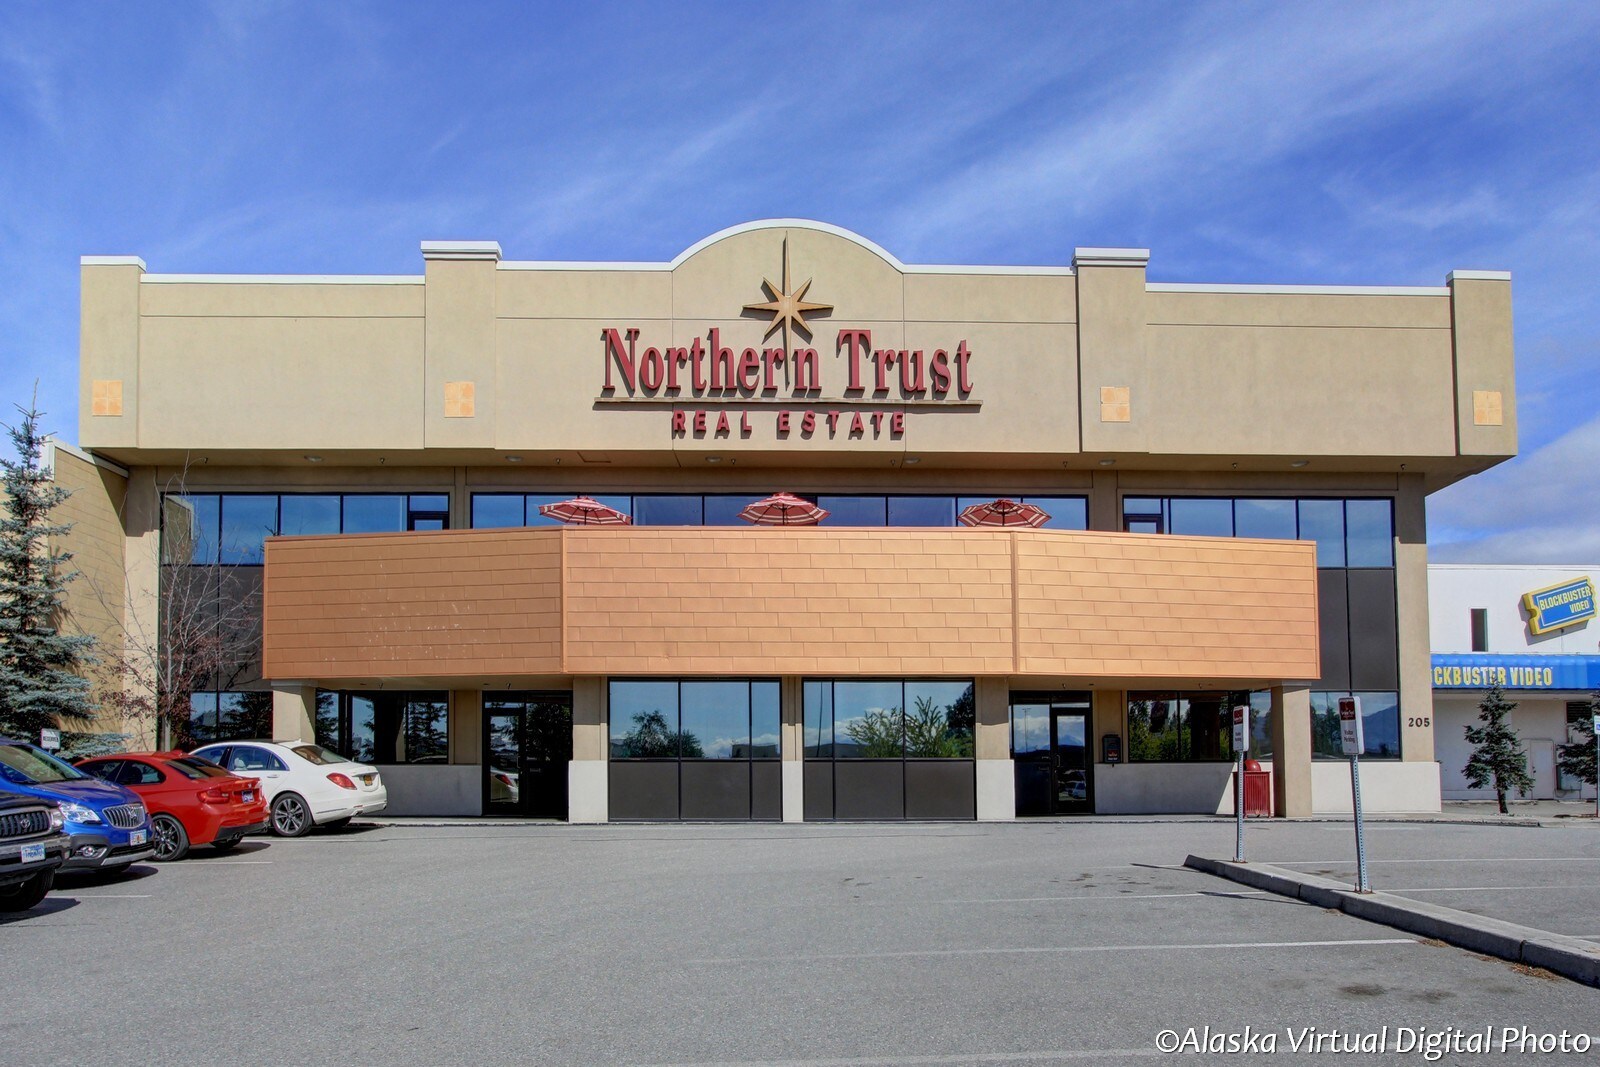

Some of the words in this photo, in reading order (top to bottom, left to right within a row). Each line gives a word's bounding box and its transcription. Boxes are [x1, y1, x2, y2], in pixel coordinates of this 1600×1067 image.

[601, 327, 822, 391] Northern
[837, 329, 974, 393] Trust
[673, 410, 752, 432] REAL
[779, 410, 905, 433] ESTATE
[1539, 586, 1591, 610] BLOCKBUSTER
[1570, 600, 1590, 613] VIDEO
[1431, 666, 1507, 686] CKBUSTER
[1509, 667, 1553, 686] VIDEO
[1408, 717, 1430, 728] 205
